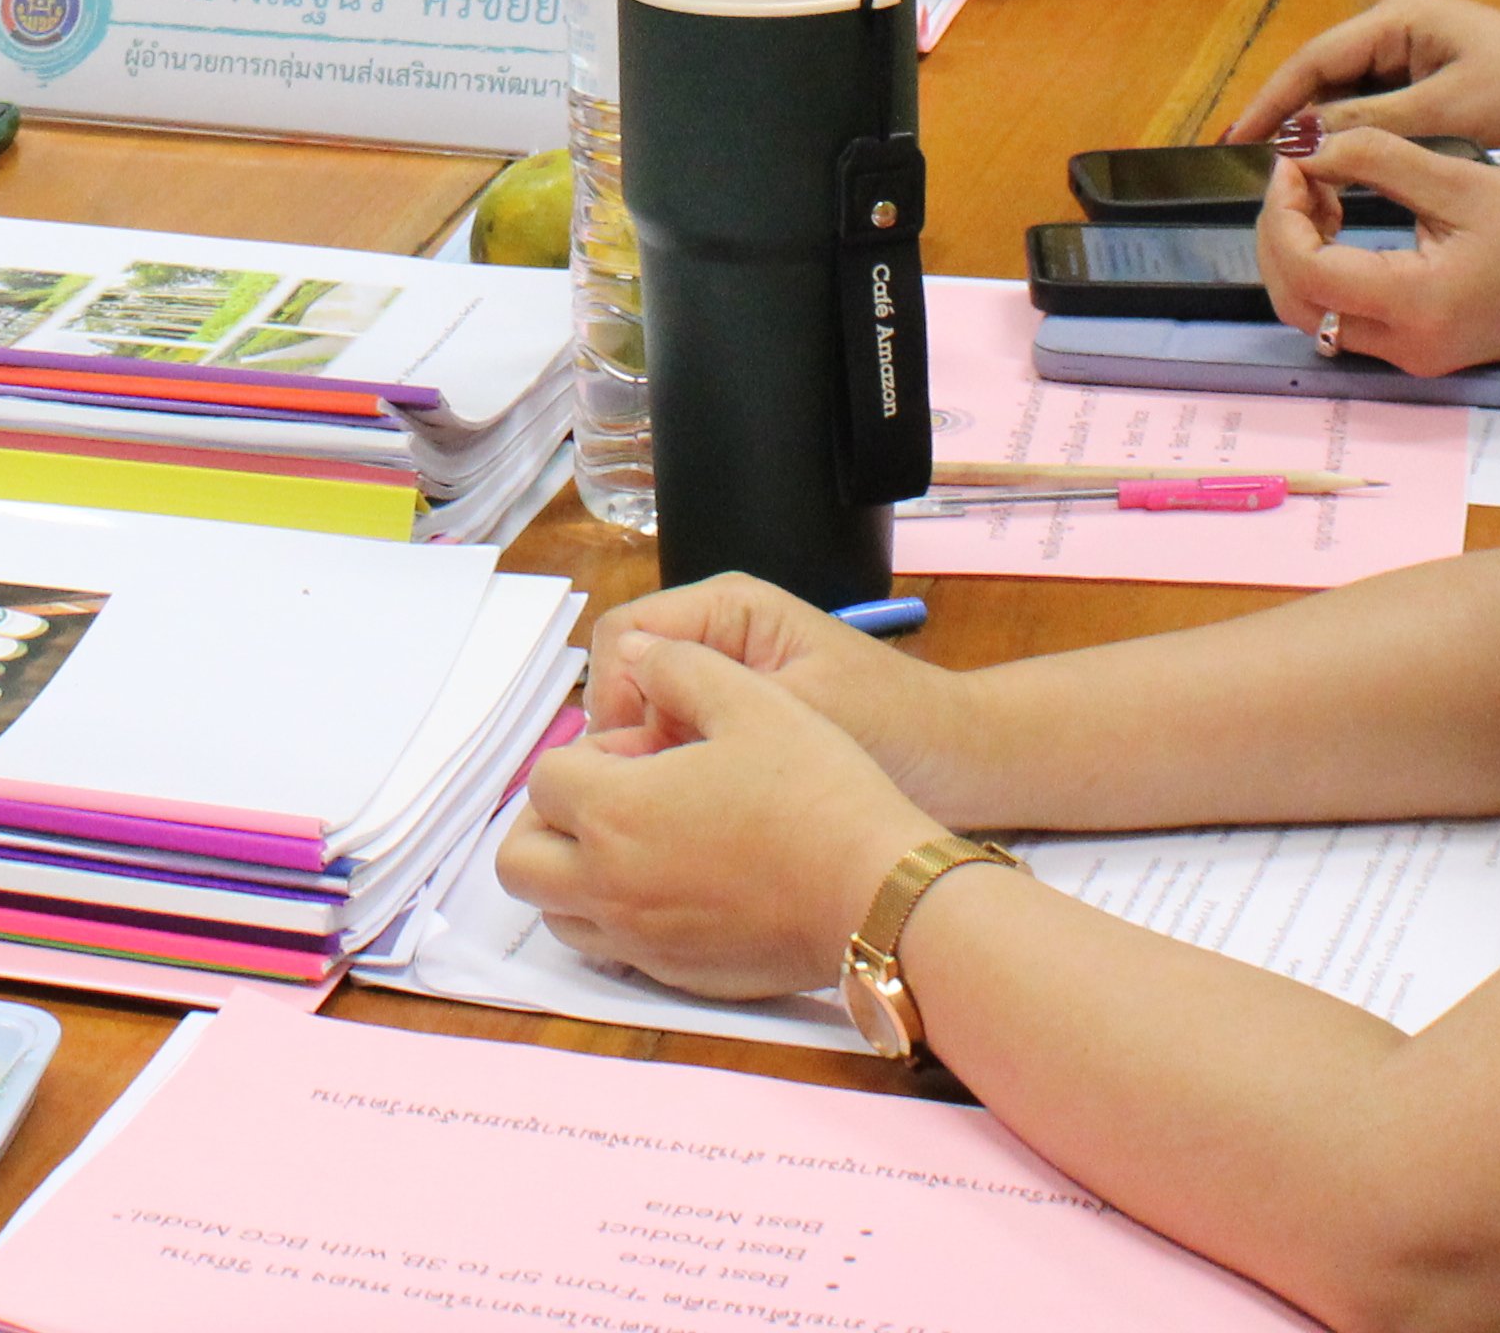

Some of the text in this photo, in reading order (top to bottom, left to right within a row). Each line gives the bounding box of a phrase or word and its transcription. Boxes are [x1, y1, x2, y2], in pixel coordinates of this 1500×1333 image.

[124, 38, 569, 99] ผู้อำนวยการกลุ่มงานส่งเสริมการพัฒนา
[872, 263, 897, 418] Café Amazon
[645, 1198, 825, 1235] Best Media
[239, 1228, 309, 1251] BCG
[320, 1239, 387, 1262] with
[597, 1219, 808, 1262] Best Product
[458, 1261, 489, 1277] to
[498, 1268, 543, 1285] 5P
[619, 1250, 790, 1289] Best Place
